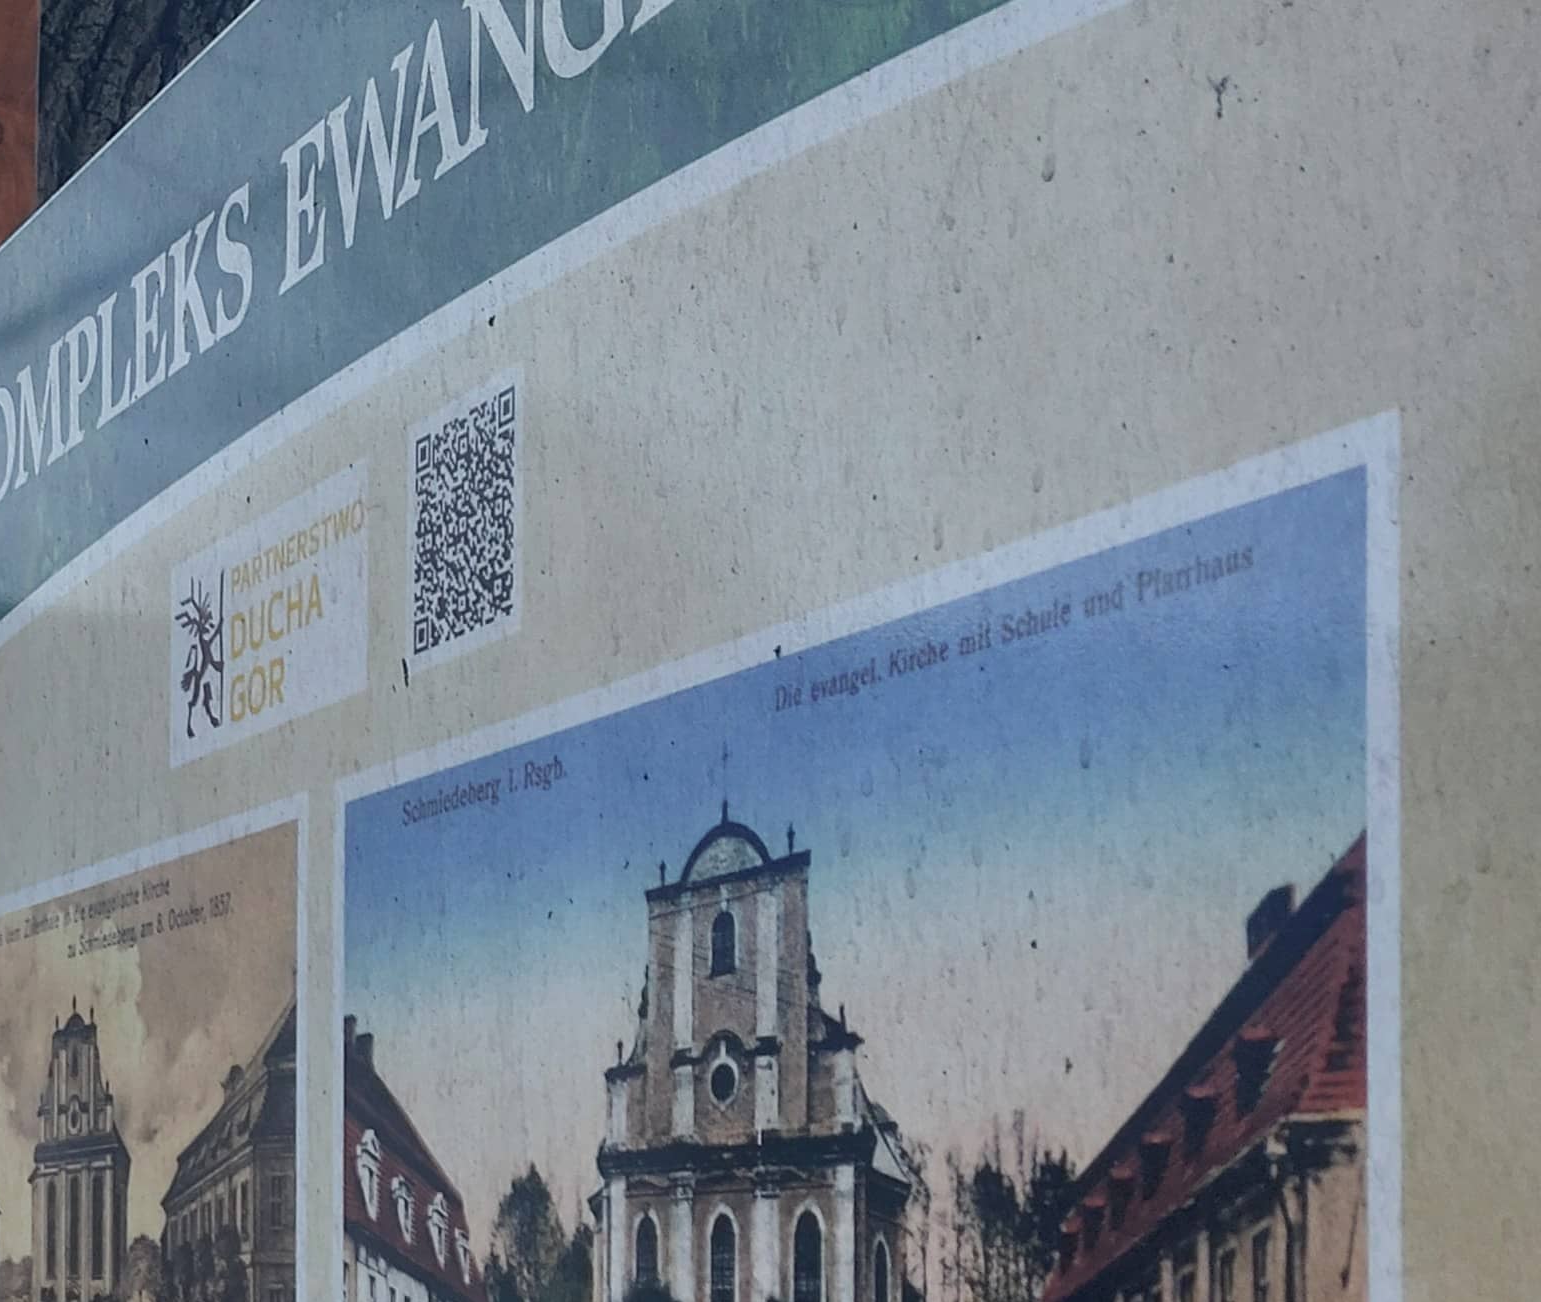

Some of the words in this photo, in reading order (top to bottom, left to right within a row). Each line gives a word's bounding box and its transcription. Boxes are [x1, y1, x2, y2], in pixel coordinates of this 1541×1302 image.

[230, 498, 365, 588] PARTNERSTWO
[230, 573, 324, 660] DUCHA
[774, 683, 803, 712] Die
[888, 641, 949, 680] Kirche
[959, 626, 992, 656] mit
[1000, 594, 1072, 645] Schule
[1083, 583, 1125, 619] und
